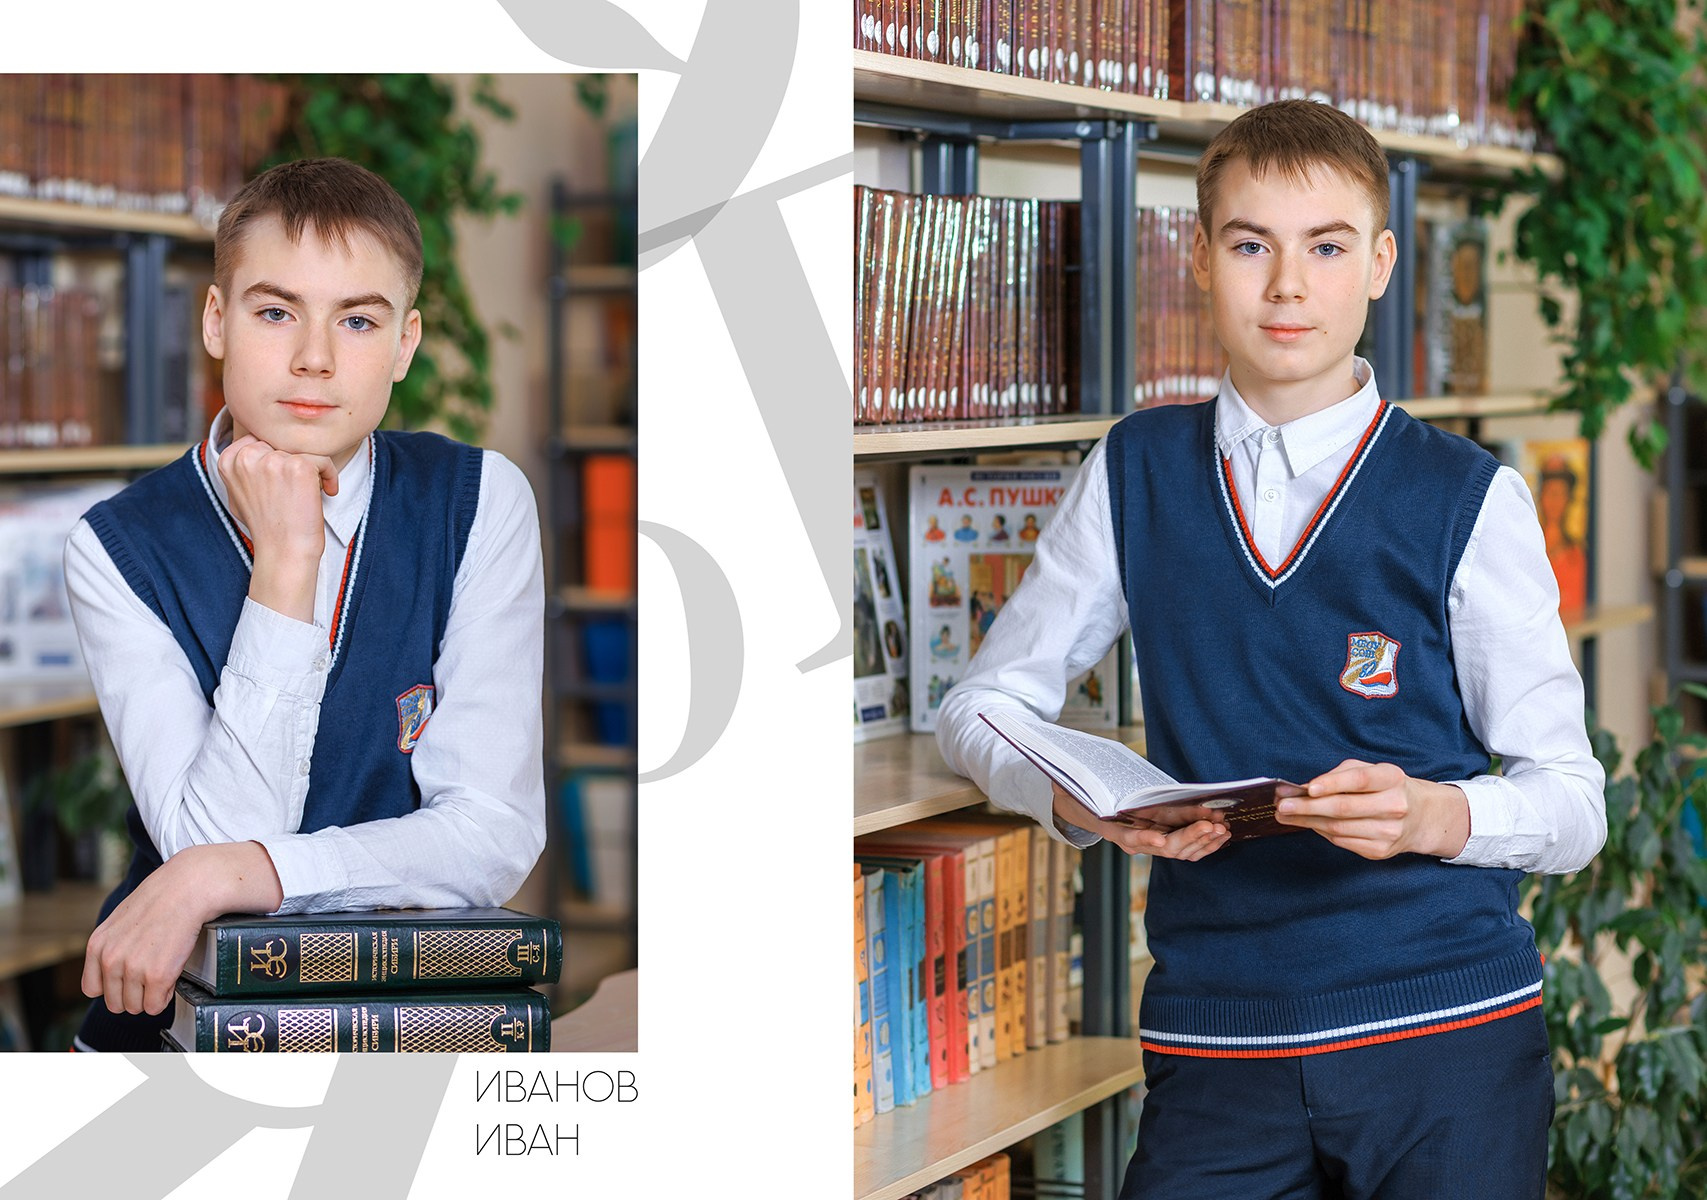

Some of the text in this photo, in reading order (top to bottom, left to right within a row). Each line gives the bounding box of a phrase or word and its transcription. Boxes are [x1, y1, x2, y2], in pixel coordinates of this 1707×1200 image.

[938, 486, 984, 507] А.С.
[371, 931, 379, 981] ИСТОРИЧЕСКАЯ
[390, 937, 399, 975] СИБИРИ
[371, 1014, 380, 1051] СИБИРИ
